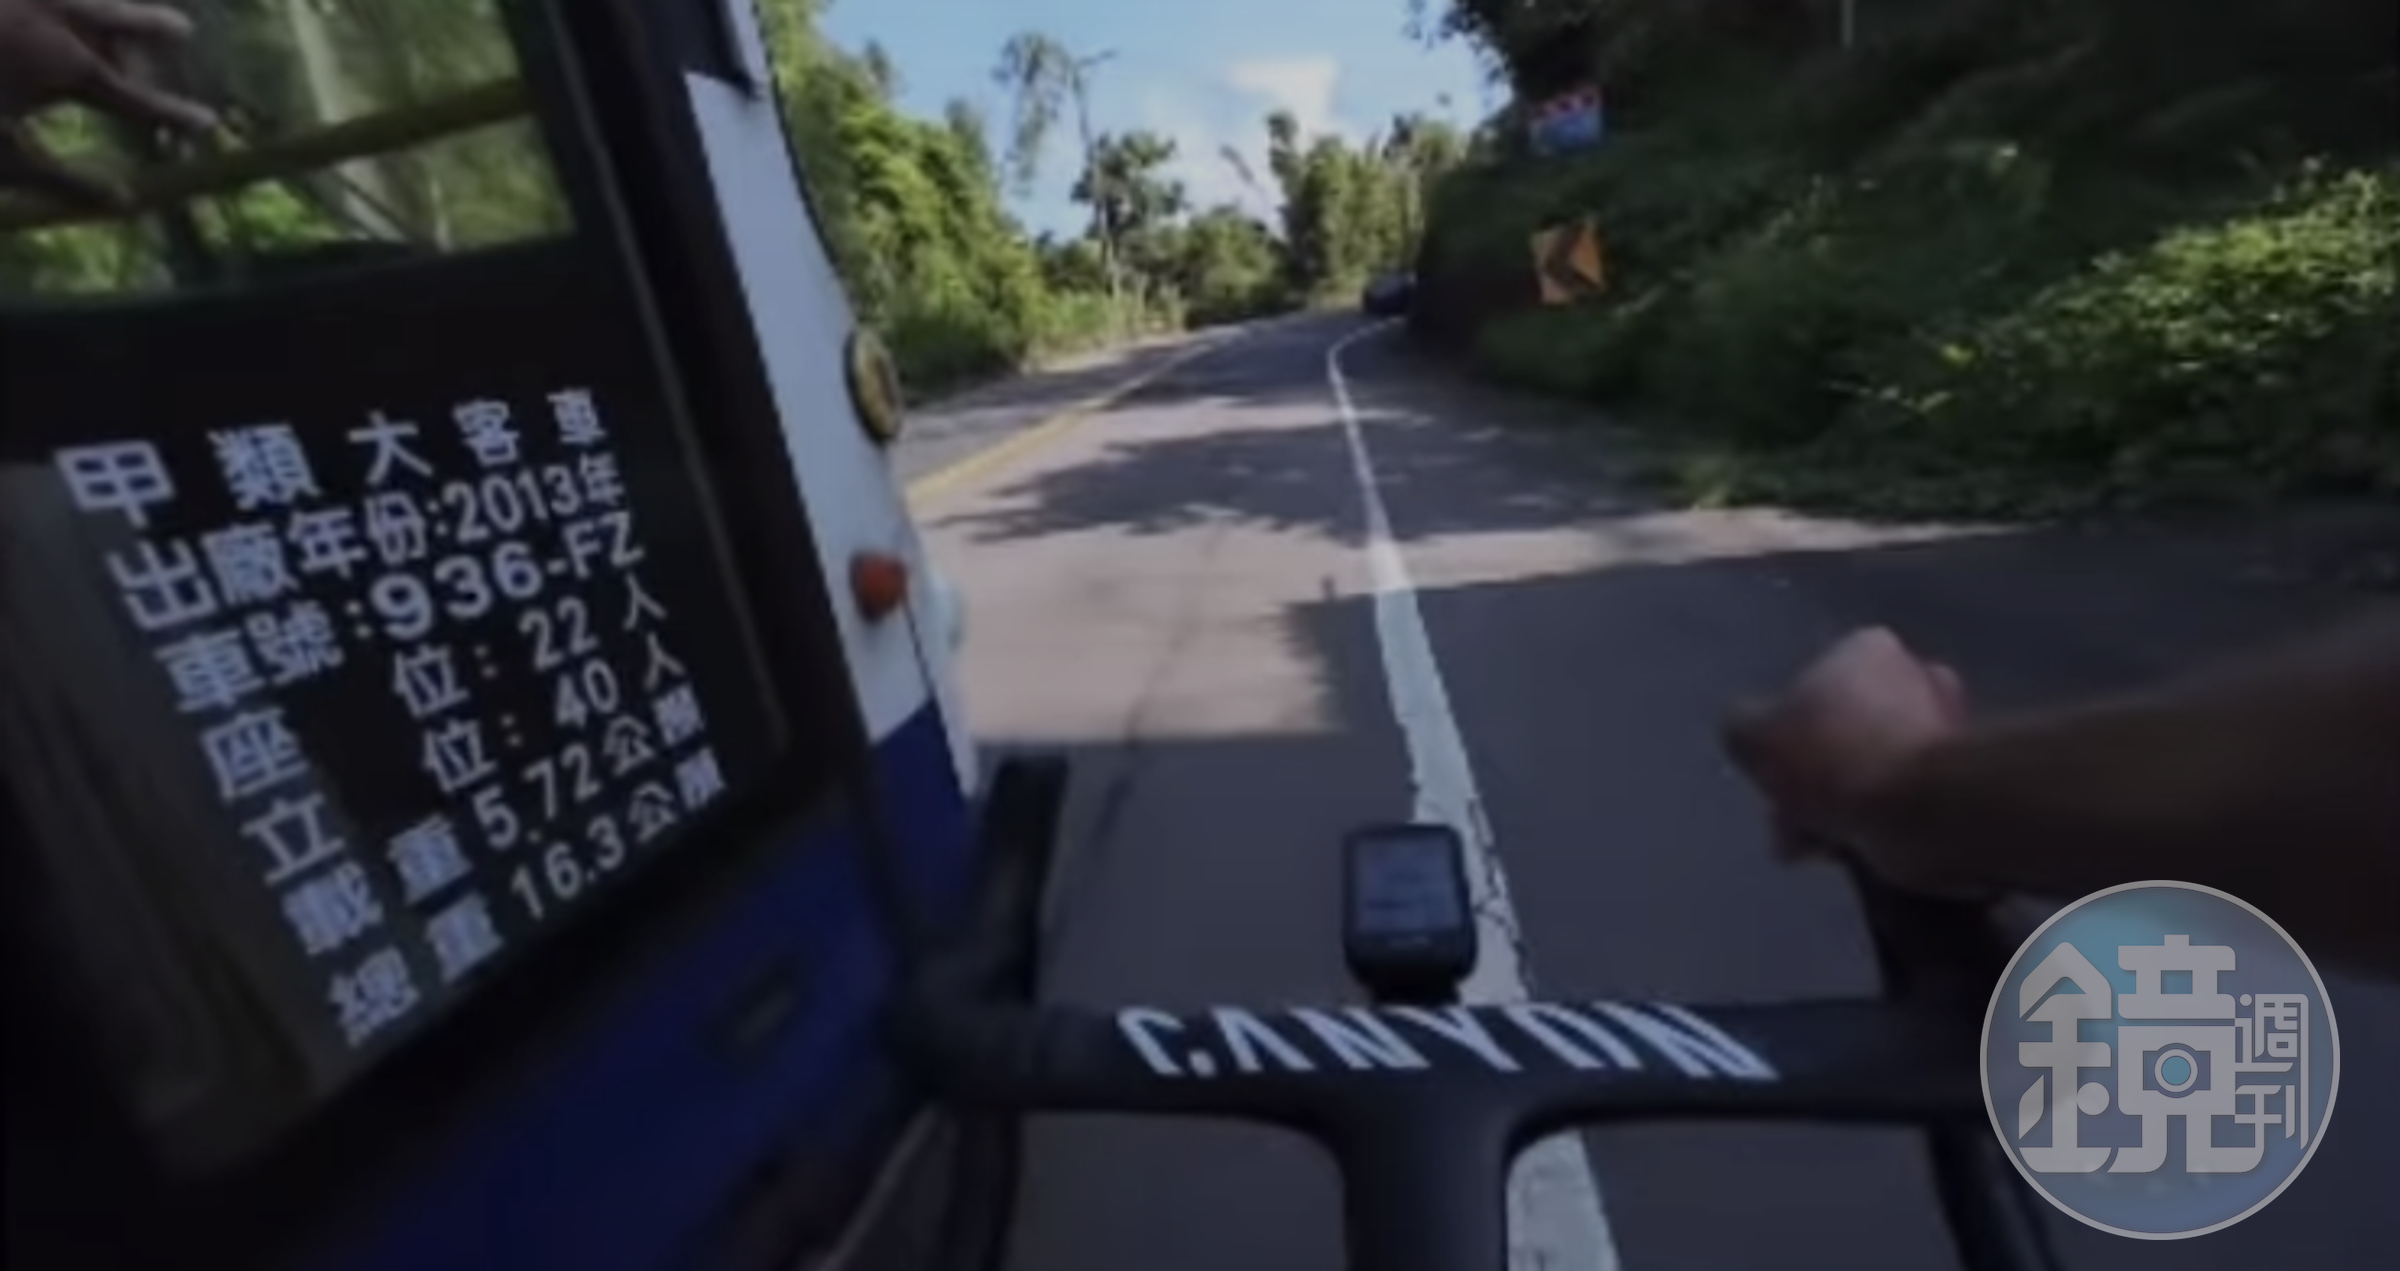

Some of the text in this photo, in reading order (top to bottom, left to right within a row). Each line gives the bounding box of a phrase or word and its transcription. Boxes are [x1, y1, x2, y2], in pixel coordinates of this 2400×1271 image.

[56, 389, 606, 527] 甲類大客車
[1117, 1005, 1778, 1079] CANYON
